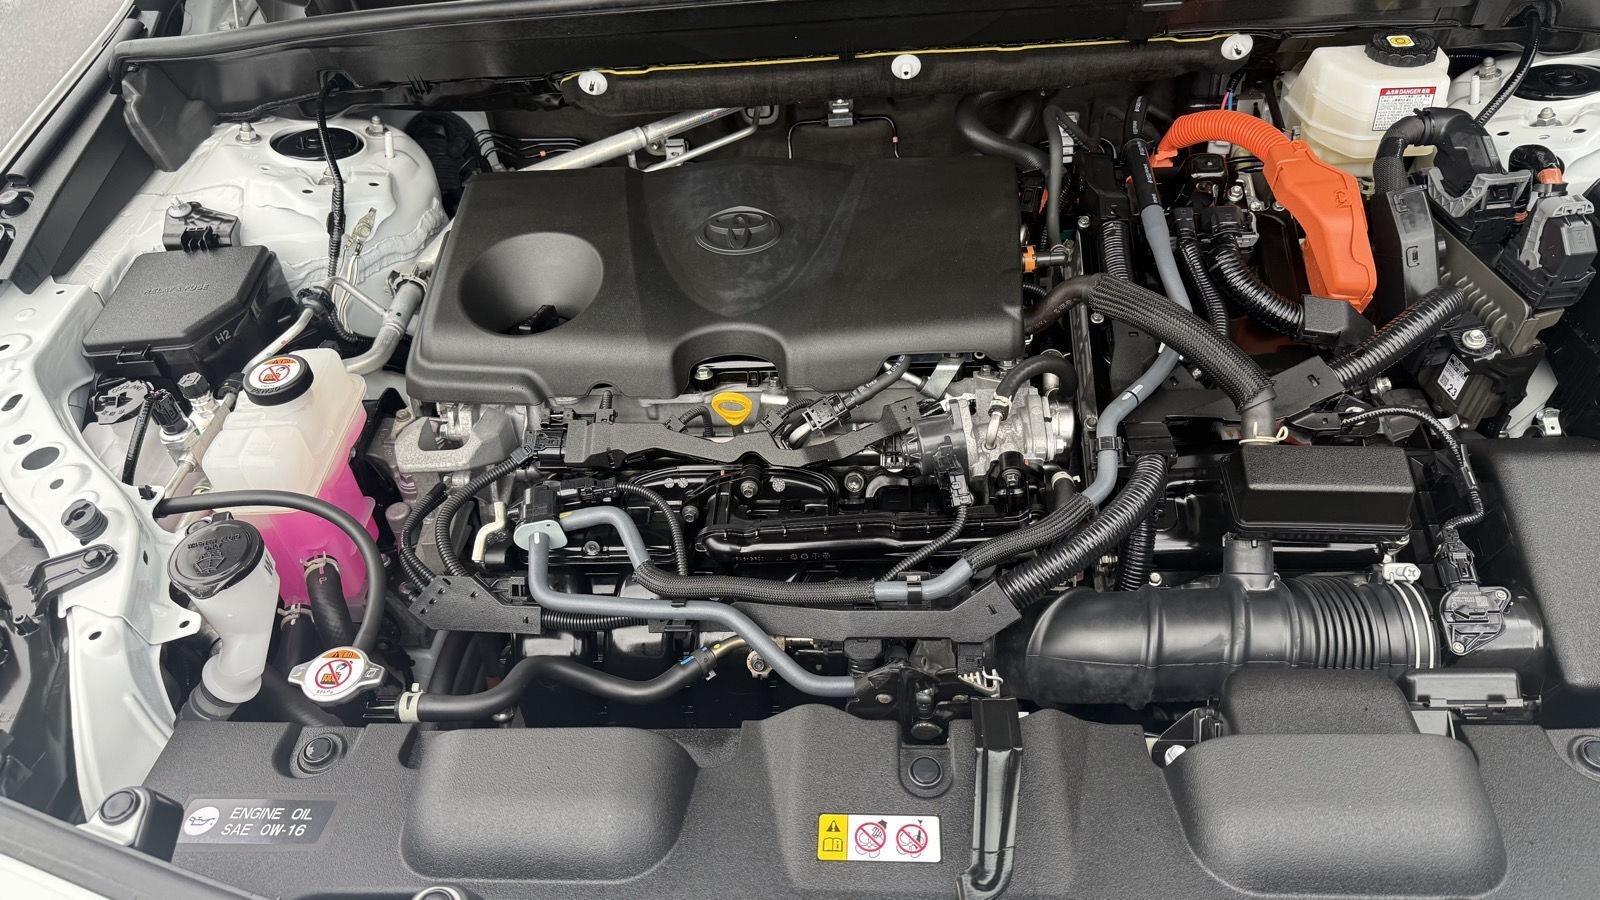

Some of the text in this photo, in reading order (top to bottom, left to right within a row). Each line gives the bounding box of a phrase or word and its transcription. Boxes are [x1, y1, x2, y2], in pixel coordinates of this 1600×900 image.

[214, 329, 231, 345] H2
[1447, 383, 1458, 397] 23
[230, 807, 313, 820] ENGINE OIL
[221, 823, 307, 837] SAE 0W-16
